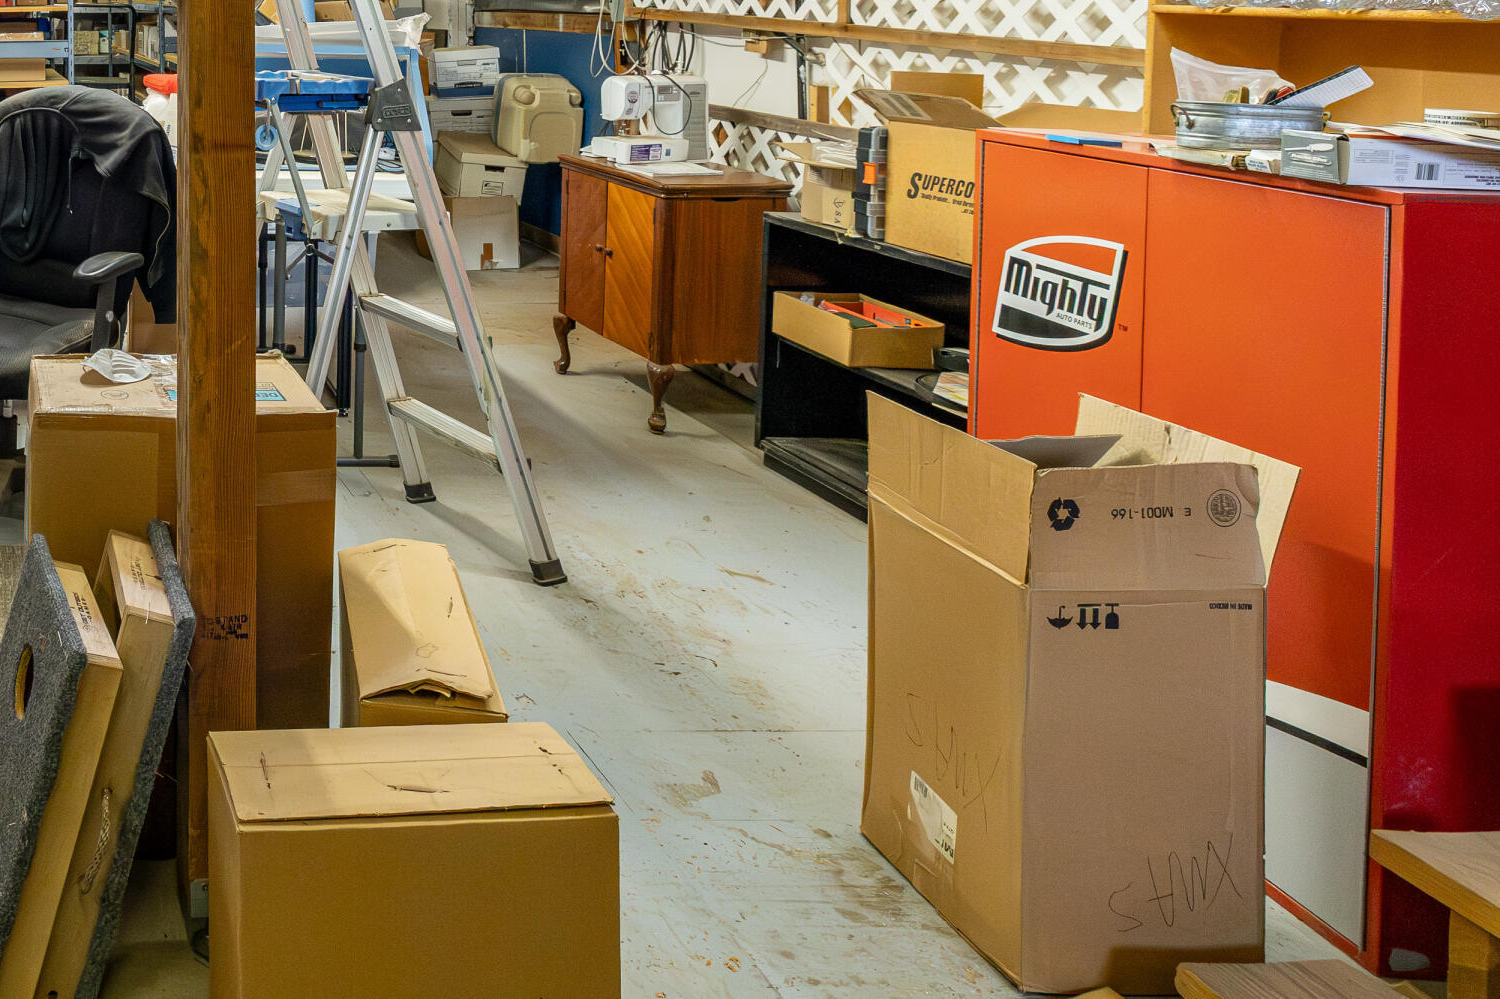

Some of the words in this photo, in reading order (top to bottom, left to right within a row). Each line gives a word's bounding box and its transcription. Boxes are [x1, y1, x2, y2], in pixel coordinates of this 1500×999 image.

[907, 172, 975, 199] SUPERCO
[1004, 255, 1111, 332] Mighty
[1056, 312, 1073, 323] AUTO
[1073, 318, 1093, 329] PARTS
[1110, 506, 1173, 520] M001-166
[1209, 602, 1229, 610] MEXICO
[1108, 832, 1243, 933] XMAS
